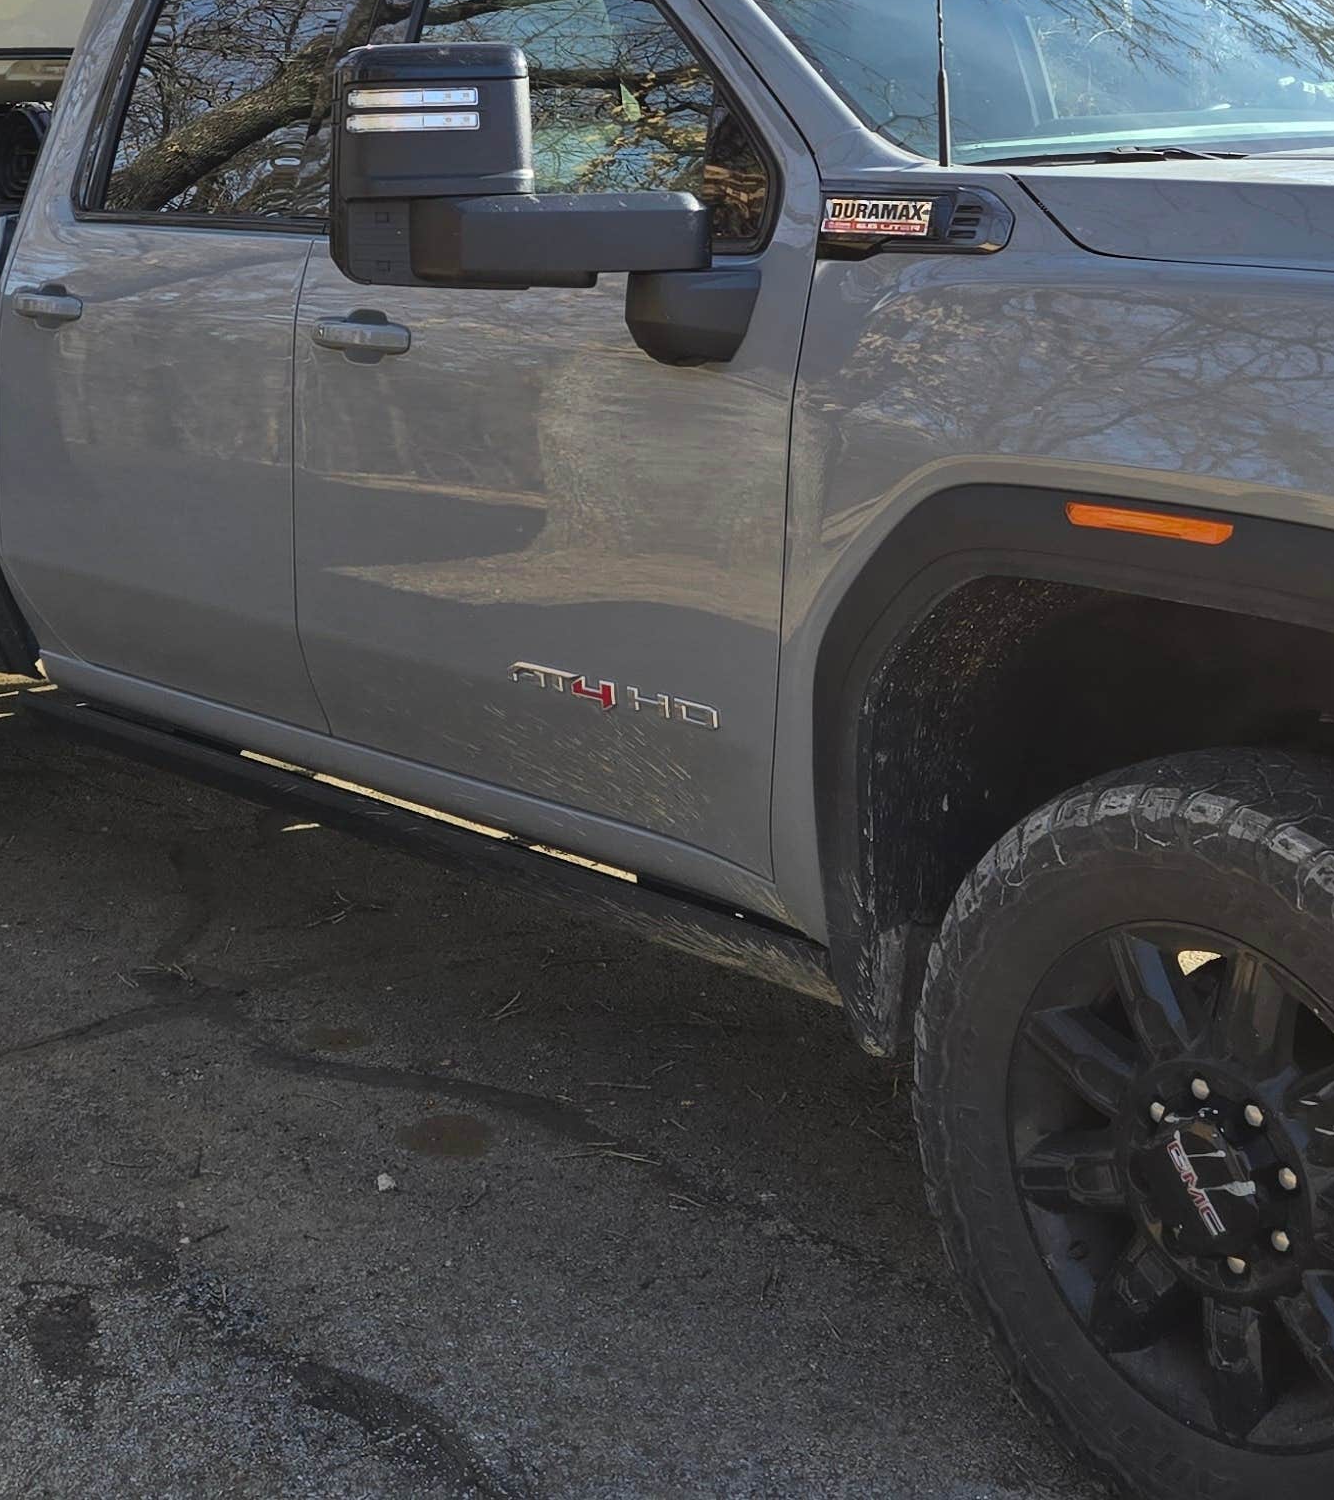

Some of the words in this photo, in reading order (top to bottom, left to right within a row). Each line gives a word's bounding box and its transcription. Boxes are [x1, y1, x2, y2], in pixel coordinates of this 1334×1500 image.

[830, 202, 926, 221] DURAMAX
[507, 661, 617, 711] AT4
[626, 685, 720, 730] HD
[1167, 1137, 1228, 1238] GMC
